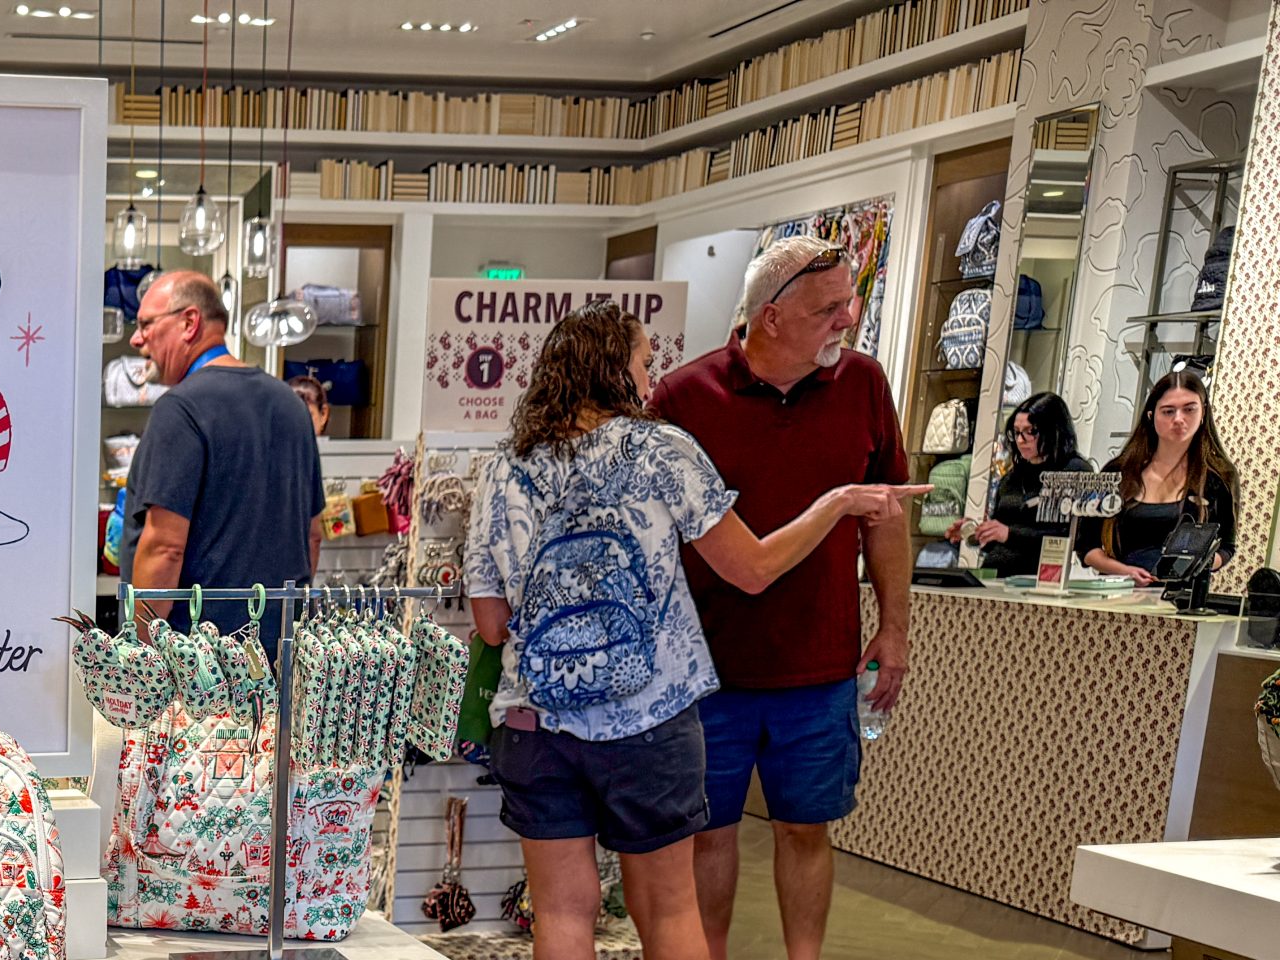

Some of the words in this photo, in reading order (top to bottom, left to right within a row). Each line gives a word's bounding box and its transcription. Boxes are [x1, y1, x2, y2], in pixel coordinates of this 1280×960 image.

[454, 291, 572, 323] CHARM
[479, 362, 489, 383] 1
[458, 396, 505, 407] CHOOSE
[464, 410, 471, 420] A
[475, 410, 498, 420] BAG
